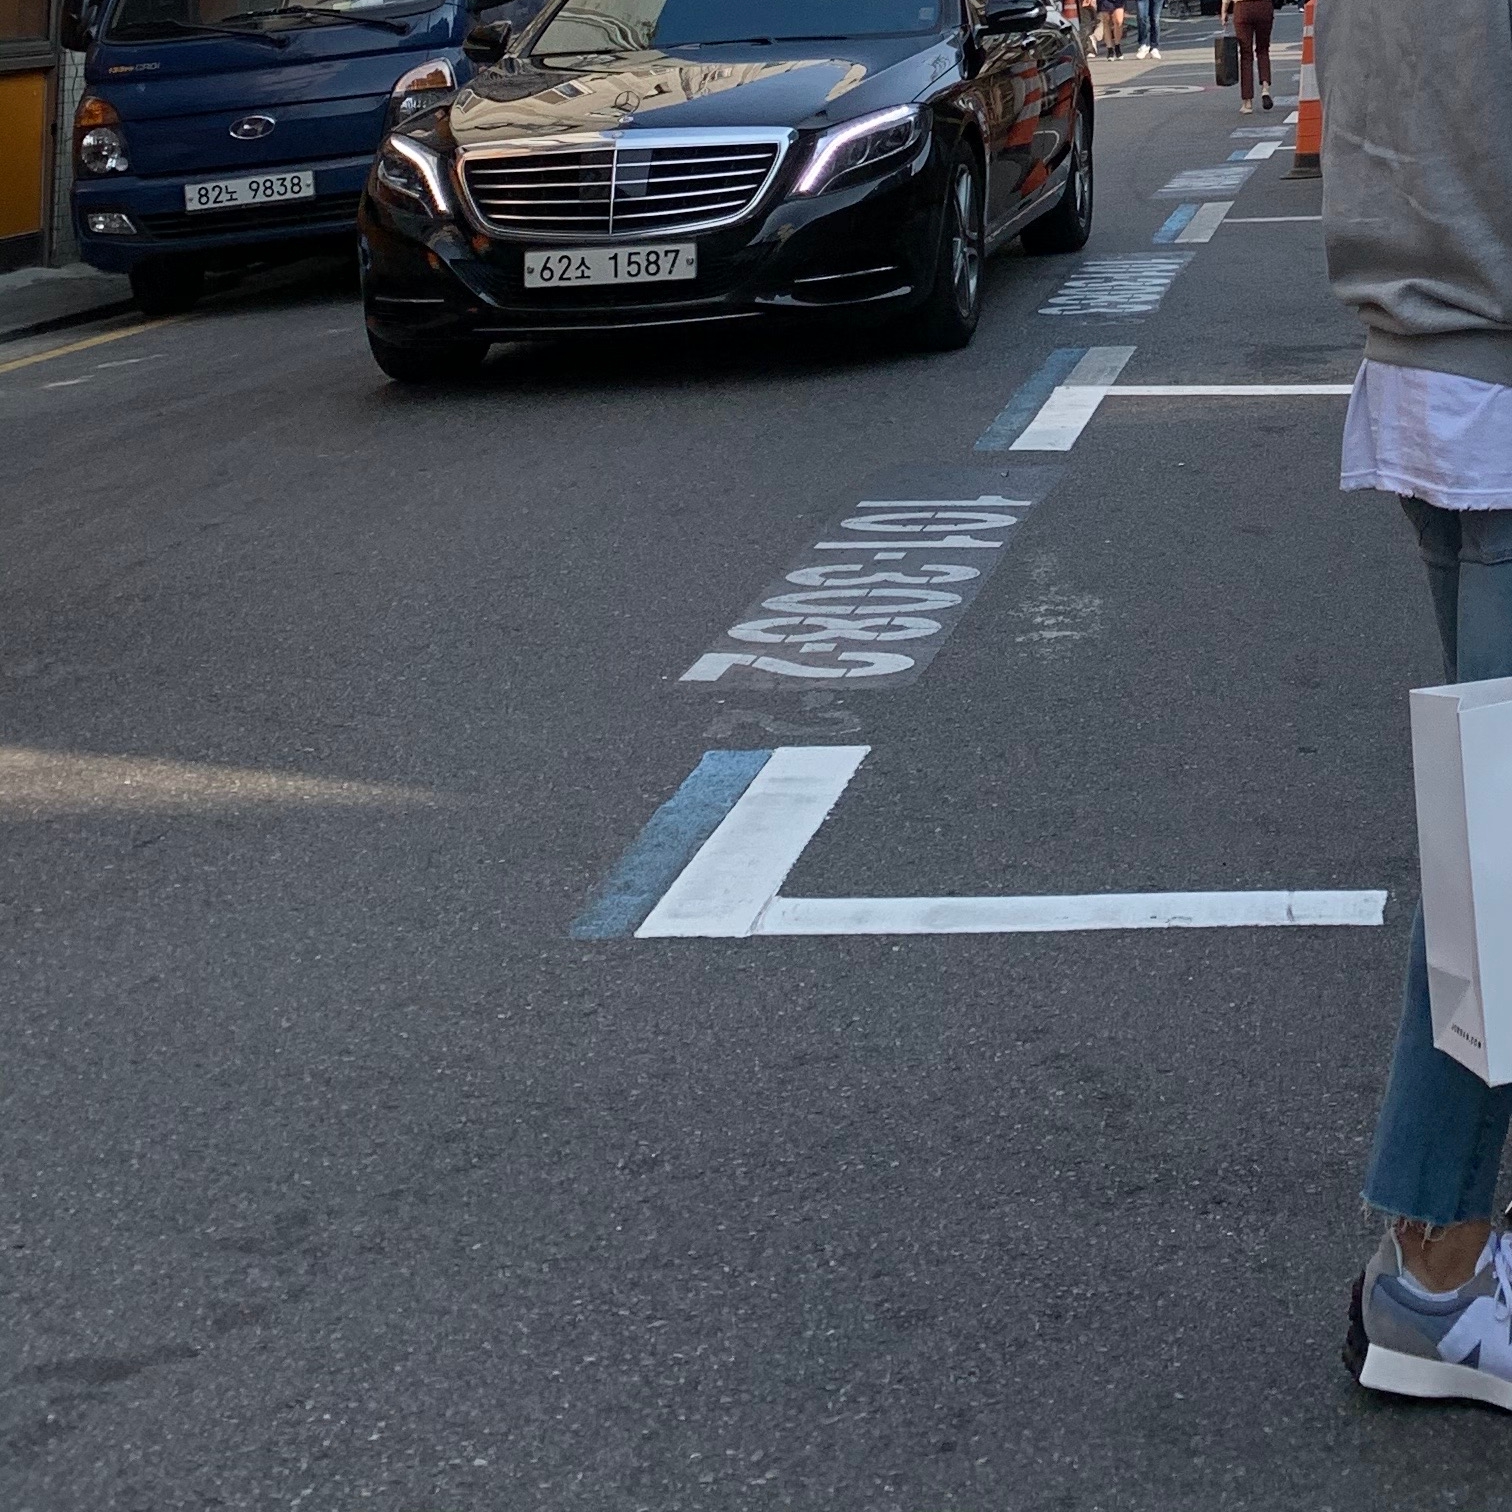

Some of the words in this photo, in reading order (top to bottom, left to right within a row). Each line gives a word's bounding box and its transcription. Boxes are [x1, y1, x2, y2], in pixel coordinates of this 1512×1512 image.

[198, 180, 239, 207] 82노
[248, 174, 306, 203] 9838
[536, 251, 591, 285] 62소
[607, 248, 683, 279] 1587
[678, 493, 1032, 683] 101-308-2
